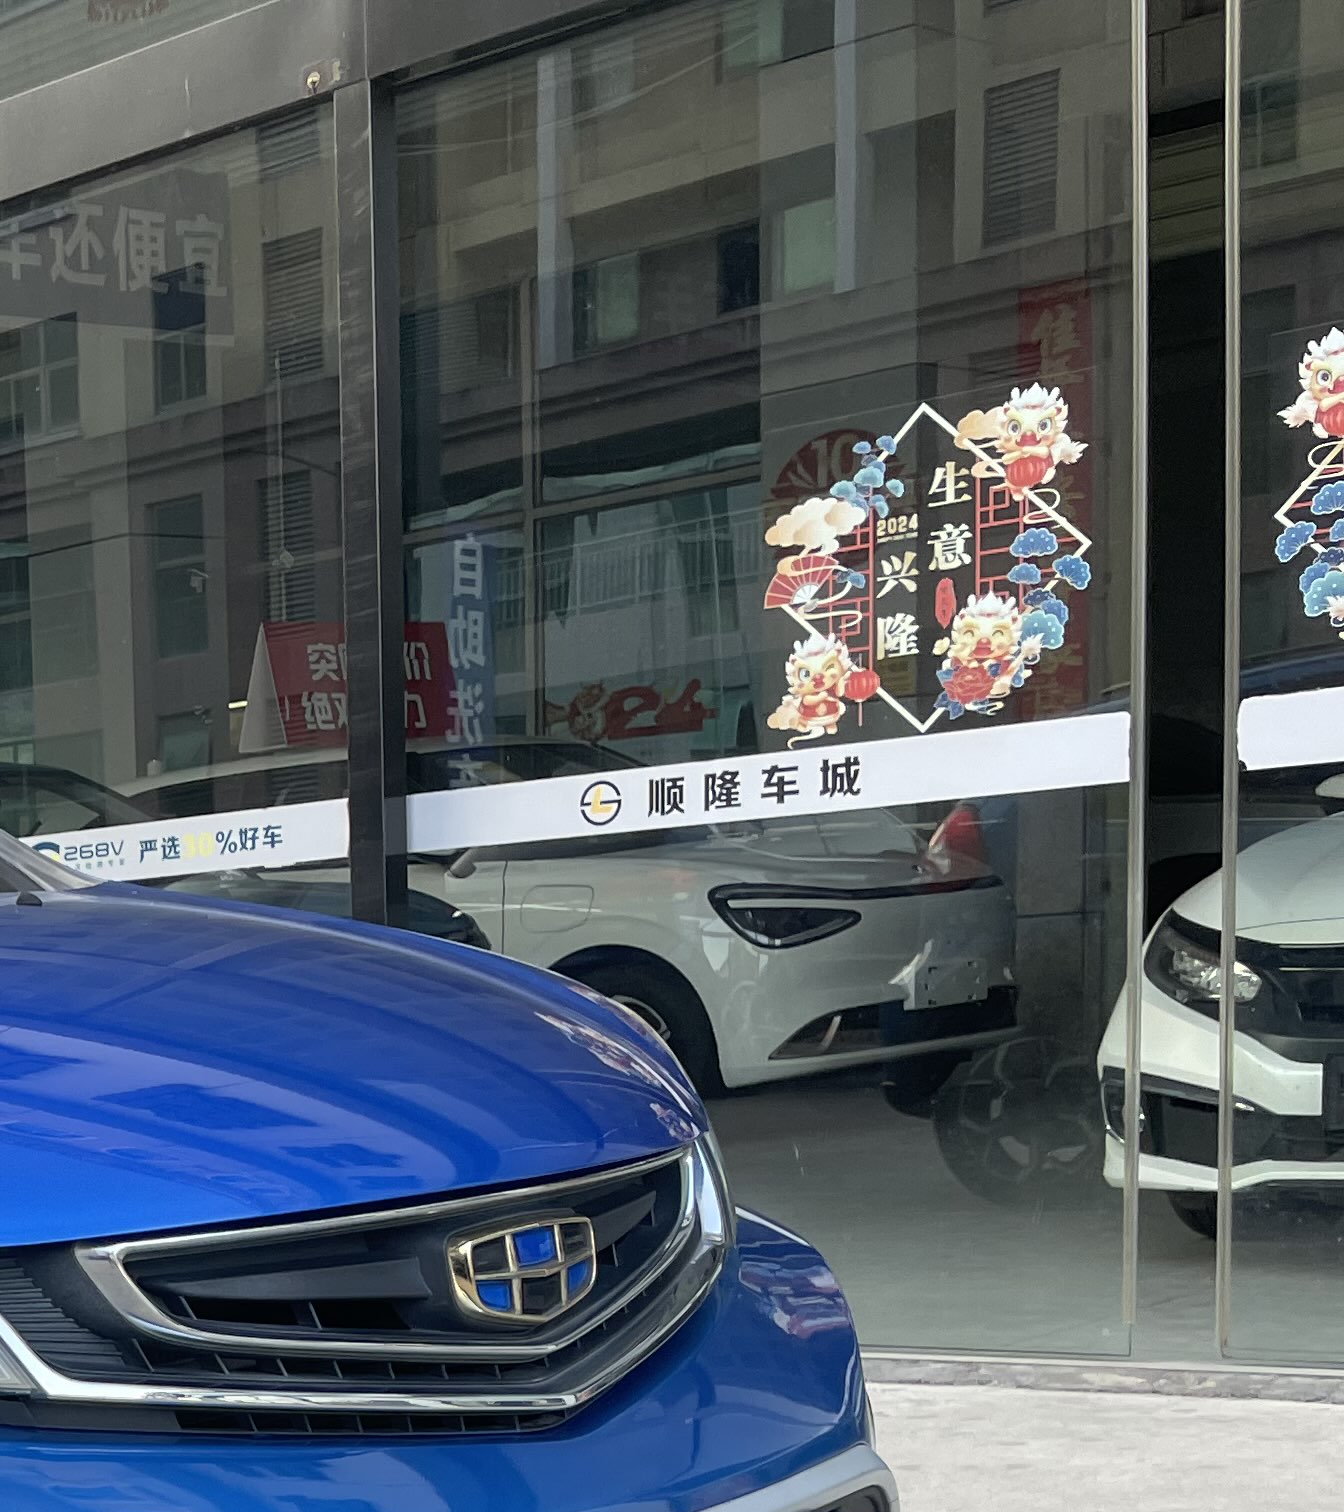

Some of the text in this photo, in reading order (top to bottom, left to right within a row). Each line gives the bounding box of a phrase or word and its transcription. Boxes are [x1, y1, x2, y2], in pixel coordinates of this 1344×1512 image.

[875, 513, 919, 538] 2024
[927, 460, 973, 572] 生意
[875, 550, 920, 661] 兴隆
[647, 755, 861, 818] 顺隆车城
[63, 839, 124, 862] 268V
